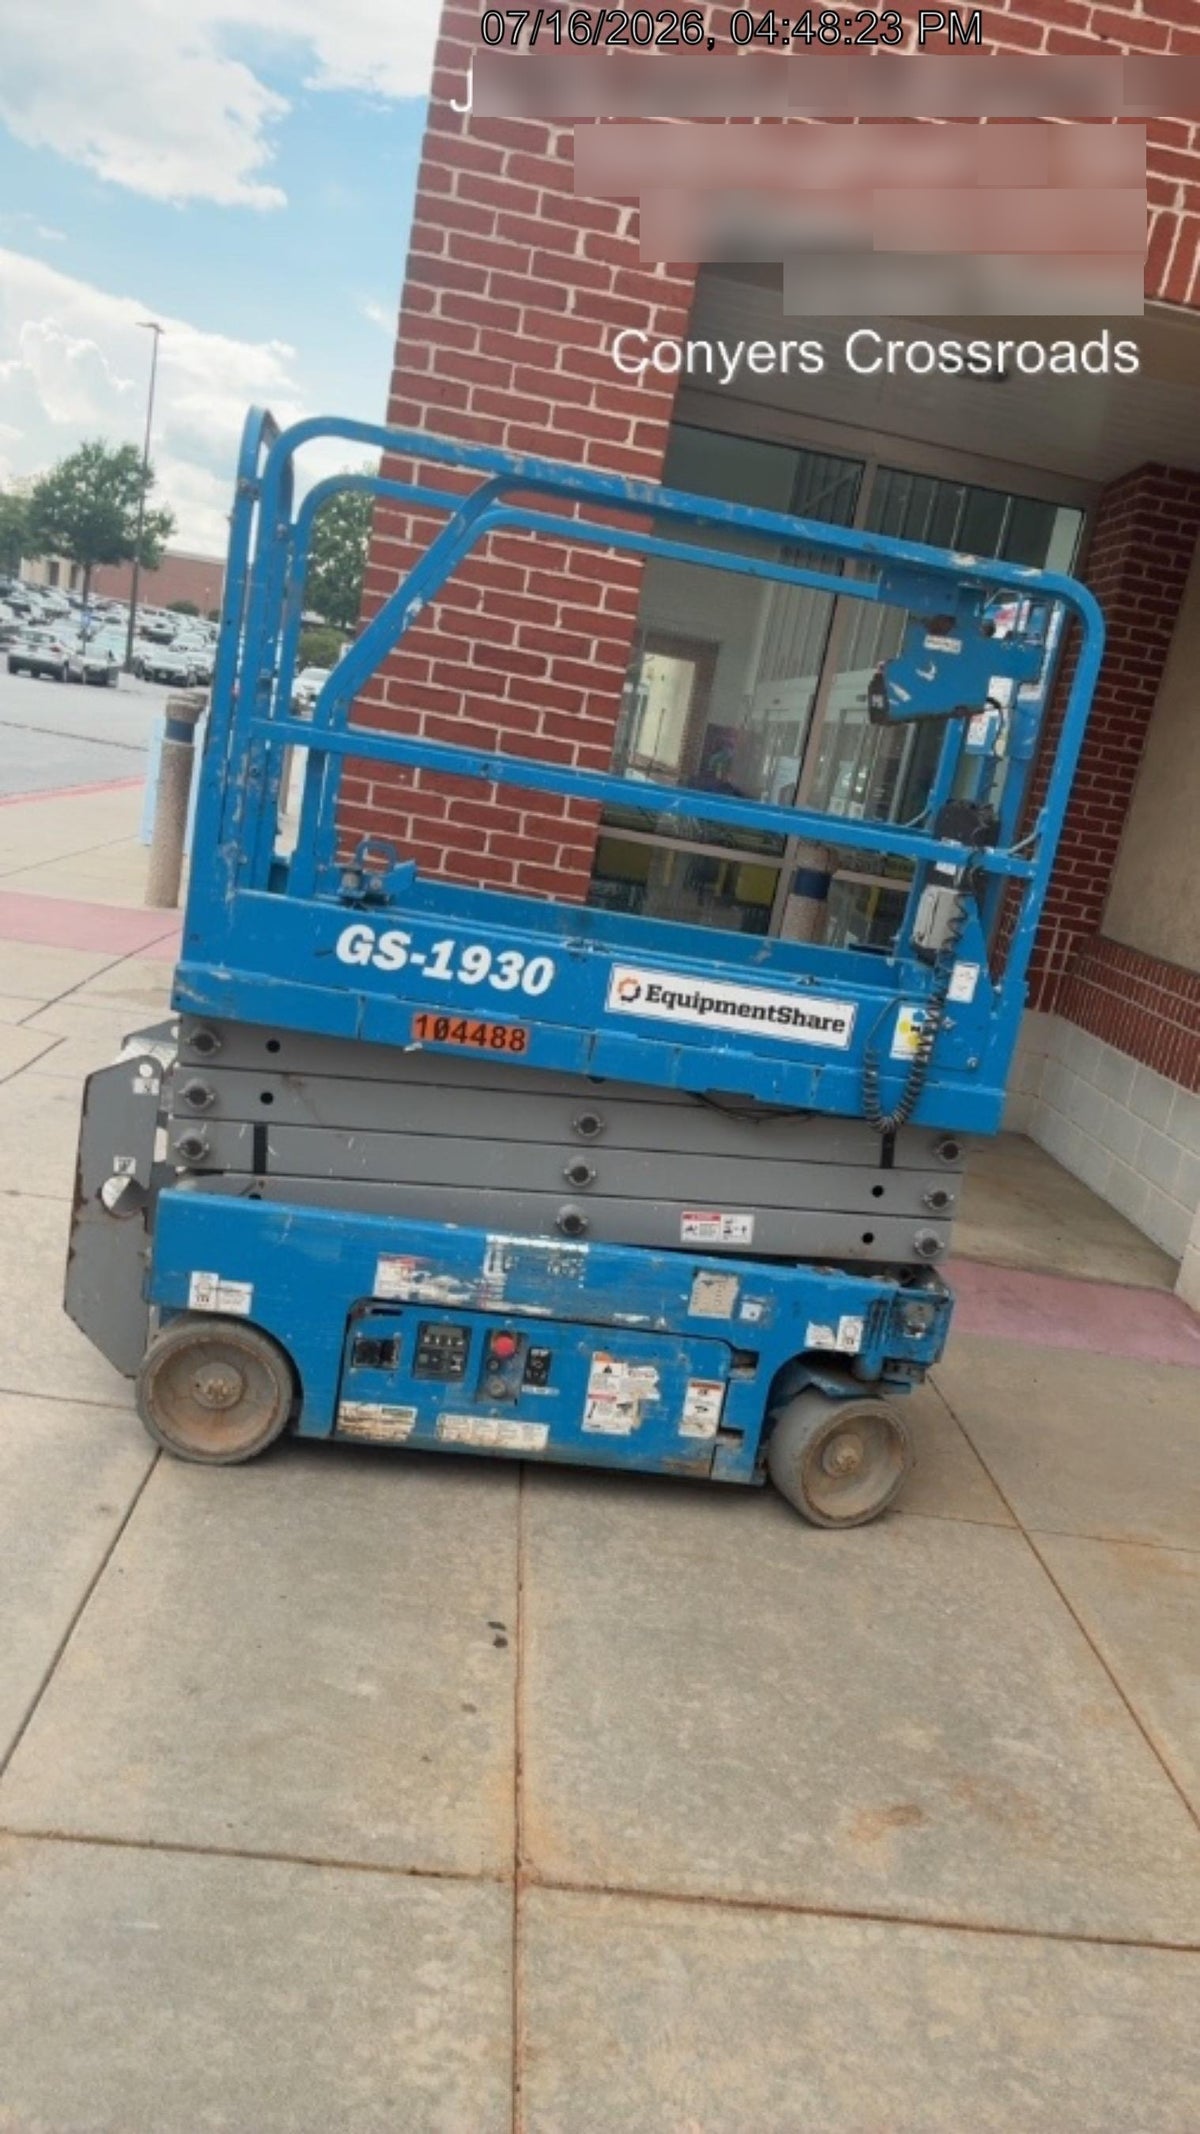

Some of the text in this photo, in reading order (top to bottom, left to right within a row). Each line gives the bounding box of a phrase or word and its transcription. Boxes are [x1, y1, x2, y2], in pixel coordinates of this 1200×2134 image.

[336, 924, 556, 996] GS-1930
[416, 1014, 527, 1052] 104488
[645, 983, 846, 1033] EquipmentShare
